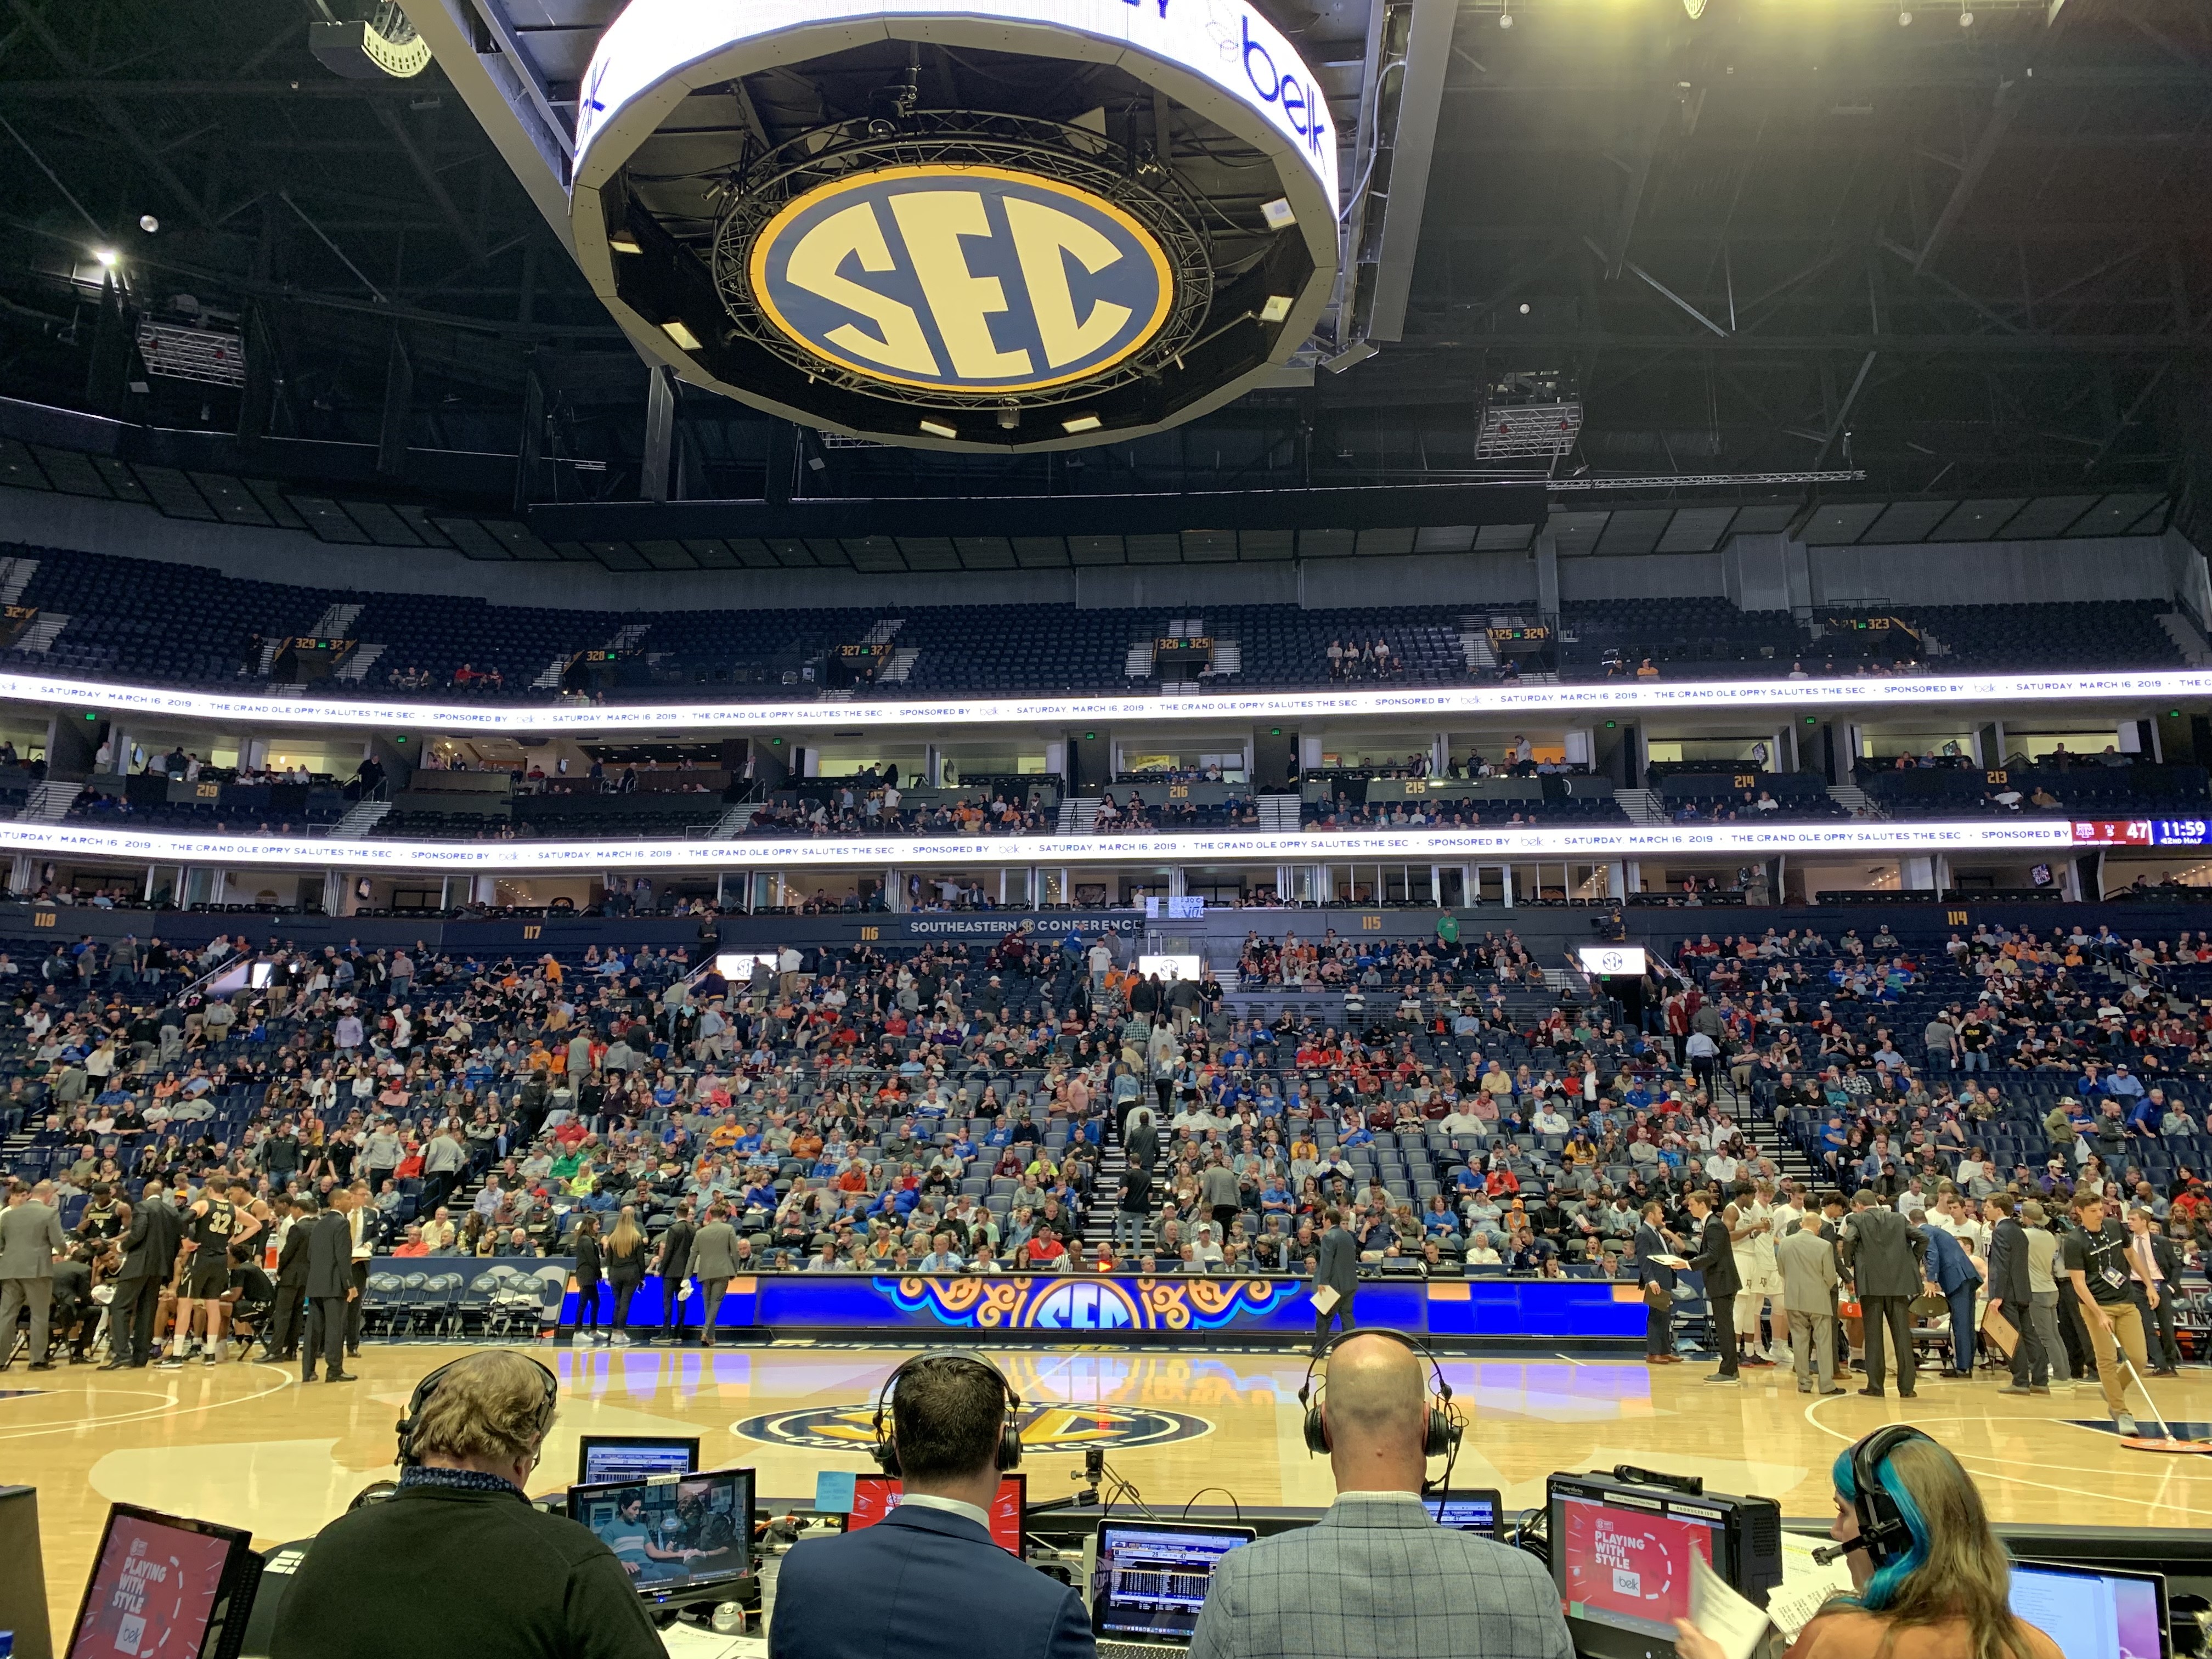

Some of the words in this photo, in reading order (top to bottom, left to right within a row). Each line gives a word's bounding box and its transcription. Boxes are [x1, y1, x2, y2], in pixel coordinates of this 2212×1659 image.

[1241, 14, 1327, 176] belk
[787, 190, 1132, 379] SEC
[1867, 618, 1890, 630] 323
[1523, 628, 1544, 640] 324
[295, 637, 317, 650] 329
[841, 645, 861, 656] 327
[1159, 639, 1179, 650] 326
[1189, 637, 1209, 649] 325
[586, 651, 605, 661] 328
[108, 692, 148, 703] MARCH
[167, 698, 192, 708] 2019
[210, 702, 231, 711] THE
[233, 704, 269, 713] GRAND
[271, 706, 292, 714] OLE
[294, 707, 321, 715] OPRY
[324, 708, 371, 717] SALUTES
[373, 710, 394, 718] THE
[395, 711, 415, 719] SEC
[433, 713, 492, 723] SPONSORED
[797, 710, 841, 718] SALUTES
[899, 708, 956, 716] SPONSORED
[1122, 704, 1144, 712] 2019
[1181, 703, 1215, 711] GRAND
[1267, 700, 1314, 709] SALUTES
[1338, 699, 1358, 707] SEC
[1375, 697, 1435, 706] SPONSORED
[1461, 695, 1482, 706] belk
[1560, 693, 1597, 701] MARCH
[1677, 690, 1714, 698] GRAND
[1739, 689, 1767, 697] OPRY
[1770, 687, 1819, 696] SALUTES
[1844, 686, 1866, 695] SEC
[1884, 685, 1948, 694] SPONSORED
[1974, 682, 1997, 693] belk
[2079, 681, 2118, 689] MARCH
[2137, 680, 2162, 688] 2019
[1734, 775, 1755, 788] 214
[1987, 771, 2008, 784] 213
[196, 784, 218, 797] 219
[1169, 786, 1188, 798] 216
[1405, 781, 1426, 794] 215
[2106, 829, 2114, 837] 5
[2126, 822, 2148, 839] 47
[2162, 821, 2206, 837] 11:59
[60, 835, 104, 845] MARCH
[124, 840, 151, 849] 2019
[170, 843, 193, 851] THE
[195, 844, 235, 853] GRAND
[236, 845, 259, 854] OLE
[261, 846, 291, 854] OPRY
[293, 847, 345, 856] SALUTES
[347, 849, 369, 857] THE
[371, 850, 392, 858] SEC
[411, 851, 474, 860] SPONSORED
[596, 850, 632, 859] MARCH
[711, 849, 747, 857] GRAND
[748, 848, 770, 856] OLE
[771, 848, 799, 856] OPRY
[801, 847, 849, 856] SALUTES
[874, 847, 895, 855] SEC
[912, 845, 973, 854] SPONSORED
[975, 845, 990, 853] BY
[999, 844, 1021, 855] belk
[1098, 843, 1136, 851] MARCH
[1153, 842, 1177, 850] 2019
[1193, 842, 1215, 850] THE
[1216, 841, 1254, 850] GRAND
[1255, 840, 1278, 849] OLE
[1279, 840, 1308, 849] OPRY
[1310, 839, 1361, 848] SALUTES
[1363, 839, 1385, 848] THE
[1387, 839, 1409, 847] SEC
[1427, 838, 1493, 847] SPONSORED
[1495, 838, 1511, 846] BY
[1521, 836, 1545, 847] belk
[1629, 835, 1669, 844] MARCH
[1688, 834, 1713, 843] 2019
[1730, 834, 1754, 843] THE
[1756, 834, 1796, 843] GRAND
[1798, 833, 1821, 842] OLE
[1823, 833, 1854, 842] OPRY
[1857, 832, 1910, 841] SALUTES
[1912, 832, 1937, 840] THE
[1938, 831, 1961, 840] SEC
[1981, 830, 2051, 839] SPONSORED
[2053, 830, 2069, 838] BY
[34, 912, 57, 928] 118
[1362, 916, 1381, 930] 115
[1947, 911, 1968, 926] 114
[523, 926, 541, 940] 117
[861, 927, 879, 941] 116
[910, 921, 1018, 933] SOUTHEASTERN
[1602, 952, 1623, 971] SEC
[208, 1211, 232, 1235] 32
[1847, 1305, 1853, 1313] G
[1594, 1530, 1646, 1550] PLAYING
[1594, 1541, 1625, 1558] WITH
[1595, 1553, 1630, 1571] STYLE
[122, 1556, 167, 1583] PLAYING
[119, 1572, 146, 1595] WITH
[1618, 1576, 1640, 1592] belk
[112, 1590, 145, 1615] STYLE
